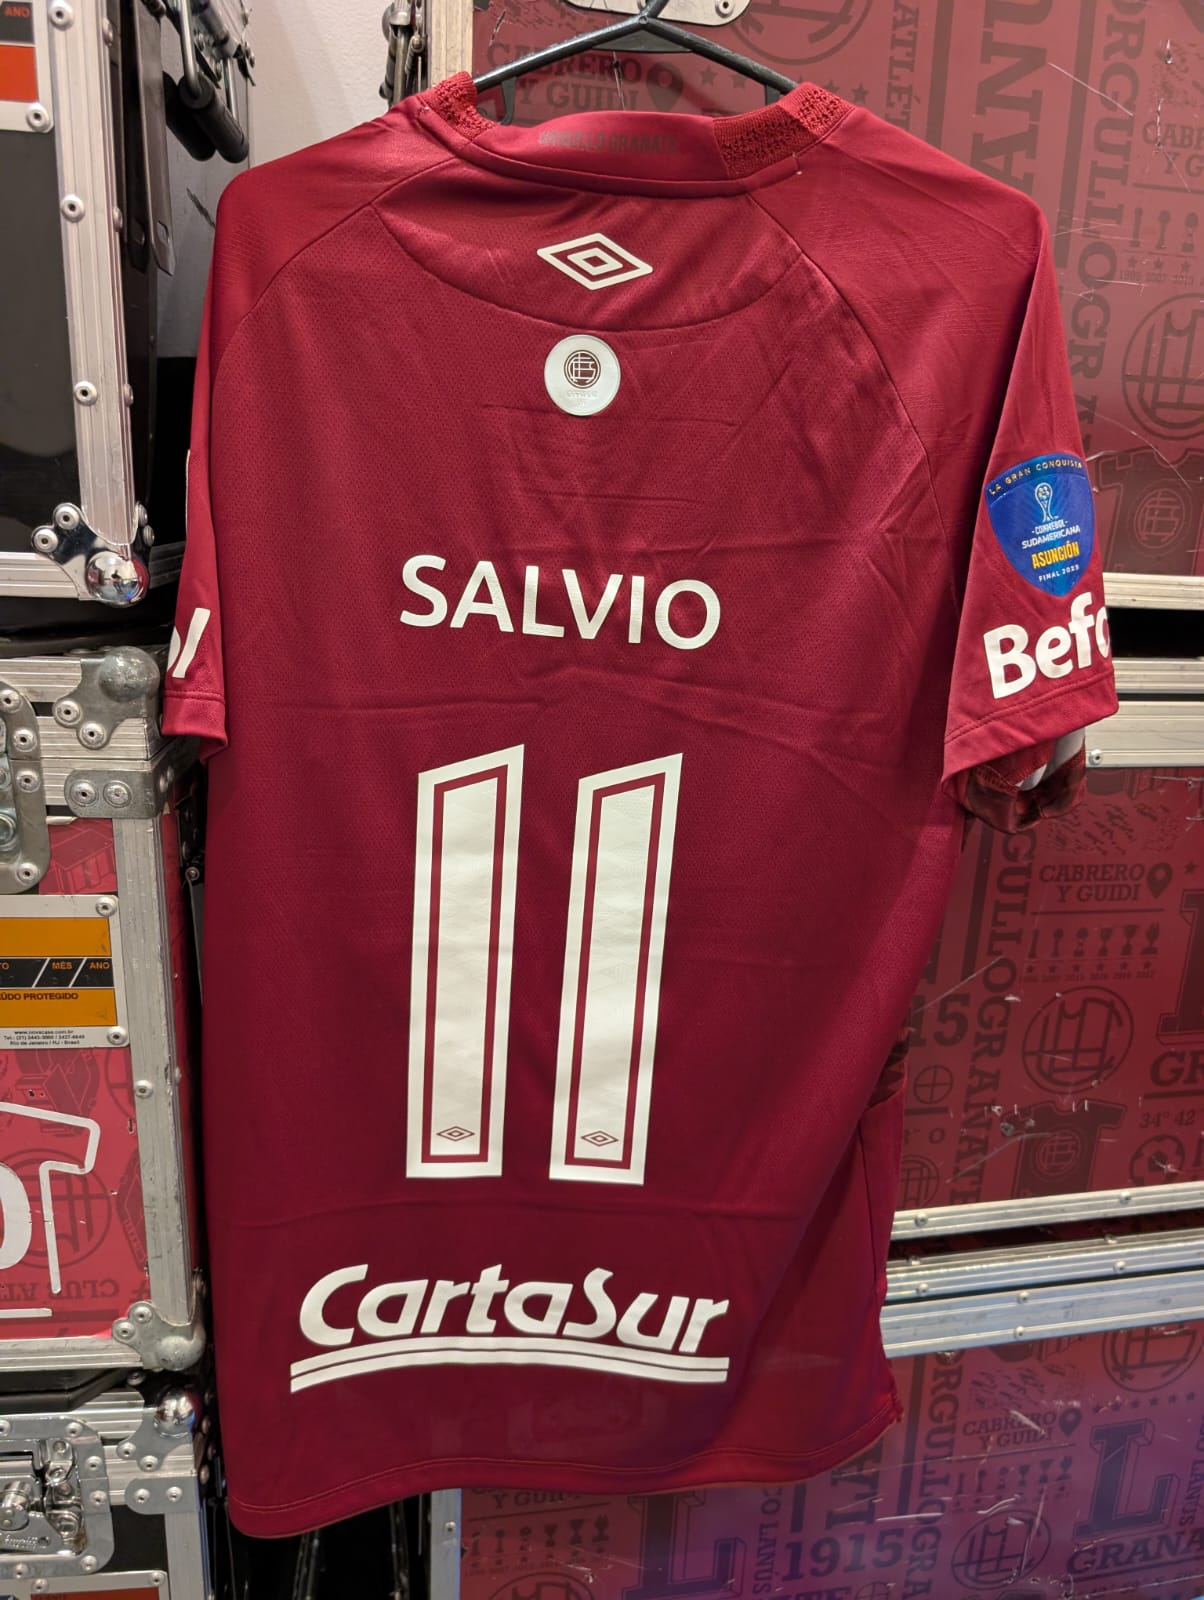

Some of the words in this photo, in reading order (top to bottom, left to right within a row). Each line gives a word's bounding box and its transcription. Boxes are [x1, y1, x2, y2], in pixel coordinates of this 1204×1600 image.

[1005, 467, 1031, 485] GRAN
[1021, 525, 1081, 549] SUDAMERICANA
[1031, 541, 1080, 569] ASUNCIÓN
[1038, 570, 1060, 582] FINAL
[400, 554, 721, 650] SALVIO
[1040, 863, 1145, 883] CABRERO
[1076, 883, 1141, 902] GUIDI
[52, 961, 73, 970] MÊS
[89, 961, 110, 970] ANO
[406, 744, 683, 1187] 11
[24, 993, 79, 1001] PROTEGIDO
[300, 1264, 730, 1354] CartaSur
[781, 1528, 905, 1582] 1915
